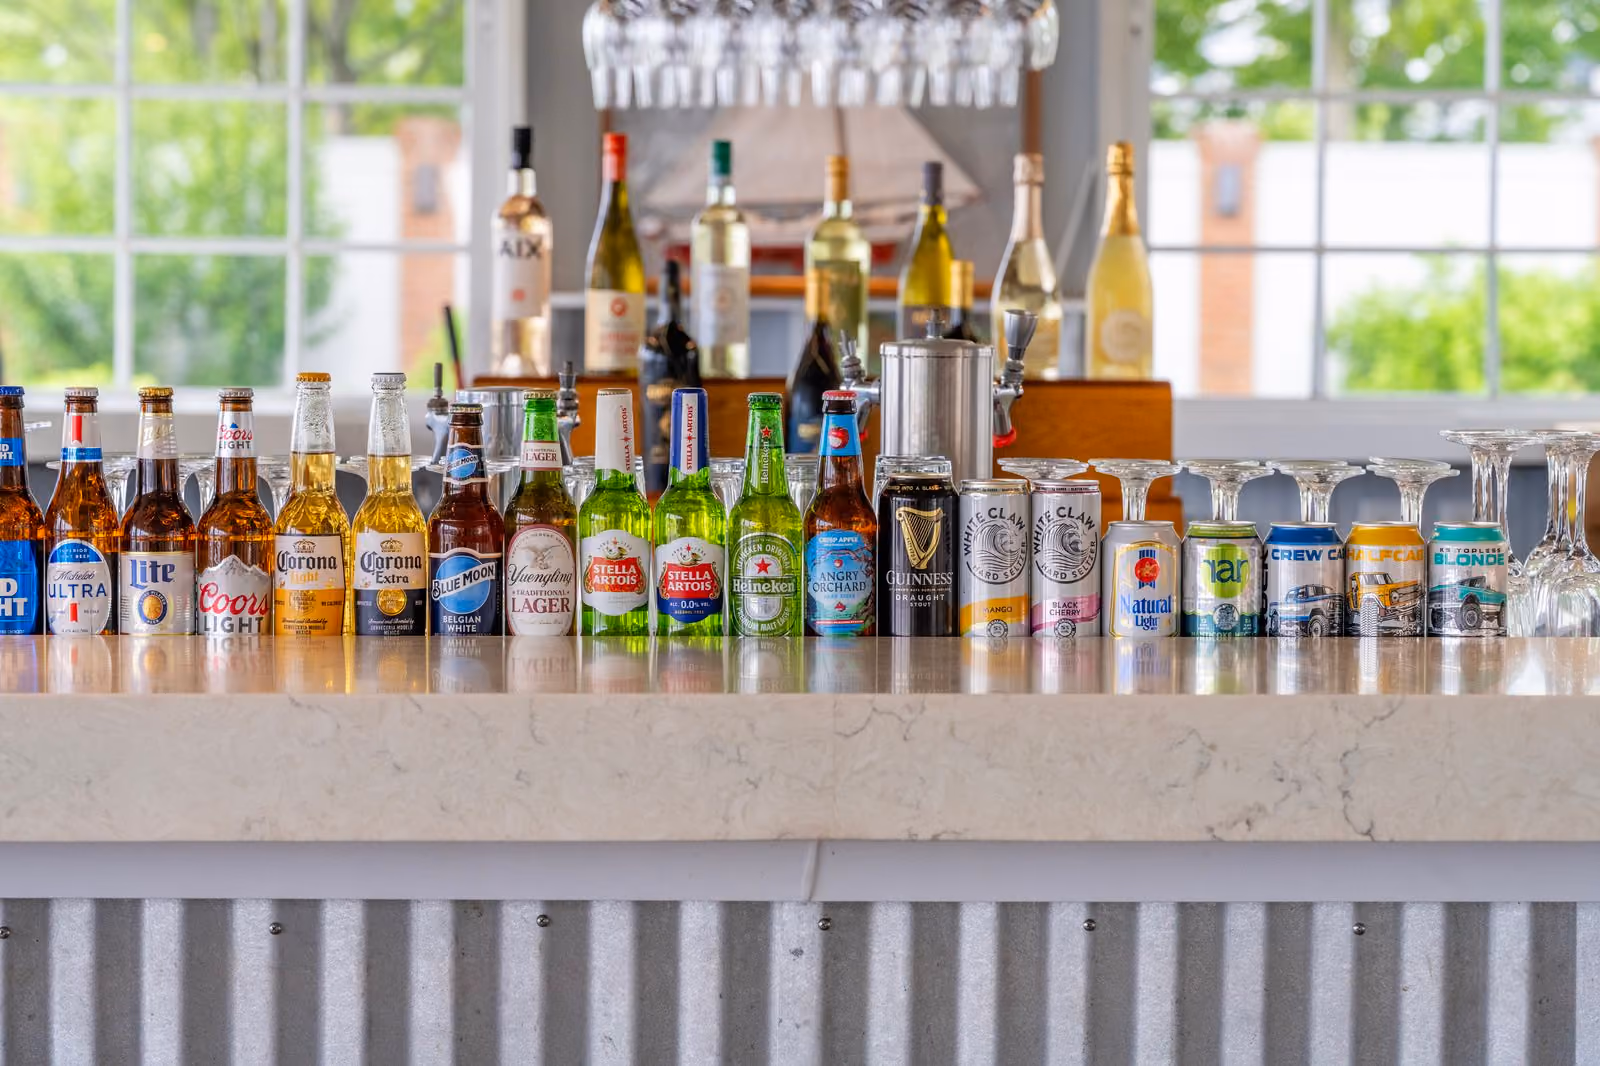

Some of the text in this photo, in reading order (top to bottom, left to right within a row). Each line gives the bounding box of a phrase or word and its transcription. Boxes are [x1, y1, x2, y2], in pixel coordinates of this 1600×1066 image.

[499, 235, 543, 259] AIX
[219, 424, 253, 441] Coors
[219, 441, 251, 449] LIGHT
[525, 452, 557, 461] LAGER
[761, 440, 769, 484] Heineken
[963, 507, 1026, 557] WHITE CLAW
[1033, 506, 1096, 555] WHITE CLAW
[972, 541, 1027, 581] HARD SELTZER
[1041, 540, 1097, 580] HARD SELTZER
[1271, 548, 1323, 561] CREW
[1433, 553, 1505, 566] BLONDE
[277, 550, 337, 575] Corona
[360, 551, 422, 575] Corona
[593, 564, 637, 575] STELLA
[54, 570, 95, 582] Michelob
[130, 559, 176, 590] Lite
[376, 571, 409, 584] Extra
[432, 564, 494, 599] BLUE MOON
[508, 563, 573, 587] Yuengling
[593, 575, 638, 586] ARTOIS
[667, 570, 711, 581] STELLA
[820, 571, 859, 581] ANGRY
[886, 570, 953, 586] GUINNESS
[48, 583, 107, 598] ULTRA
[516, 589, 566, 597] TRADITIONAL
[667, 581, 712, 591] ARTOIS
[733, 580, 796, 593] Heineken
[812, 581, 867, 593] ORCHARD
[199, 582, 270, 616] Coors
[512, 597, 571, 613] LAGER
[1052, 601, 1079, 609] BLACK
[1120, 594, 1172, 614] Natural
[204, 615, 265, 634] LIGHT
[442, 615, 482, 624] BELGIAN
[761, 621, 777, 632] MALT
[447, 624, 477, 632] WHITE
